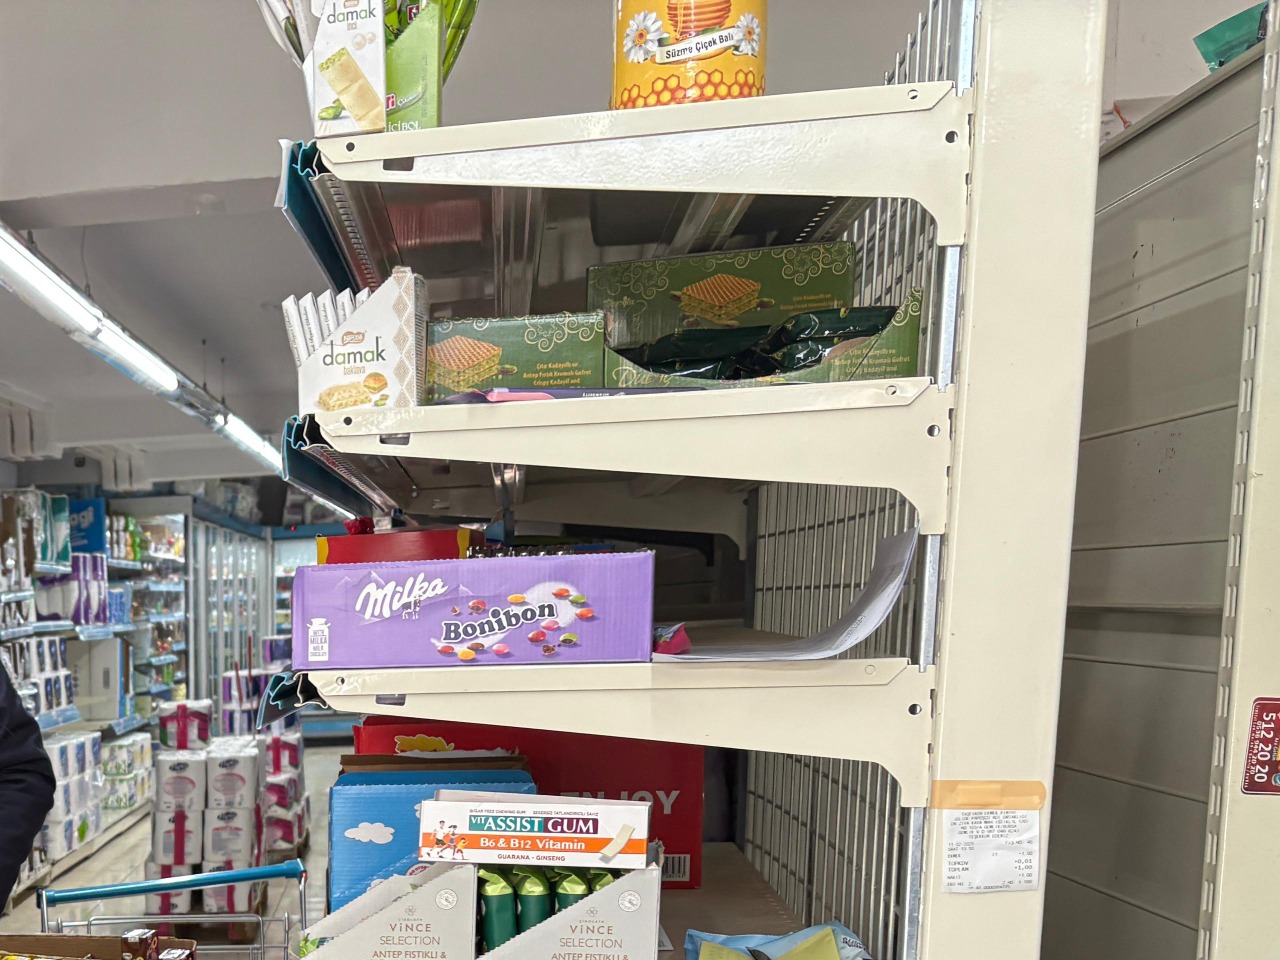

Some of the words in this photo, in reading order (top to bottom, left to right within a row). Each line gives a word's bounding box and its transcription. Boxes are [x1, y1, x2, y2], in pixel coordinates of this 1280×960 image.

[327, 1, 377, 24] damak
[666, 46, 693, 60] Süzme
[695, 36, 717, 54] Çiçek
[323, 336, 386, 366] damak
[343, 365, 366, 376] baklava
[574, 369, 592, 377] Gofret
[533, 379, 547, 387] Crispy
[355, 572, 448, 620] Milka
[442, 602, 558, 642] Bonibon
[310, 637, 327, 645] MILKA
[1260, 712, 1276, 739] 512
[1257, 743, 1271, 761] 20
[1254, 764, 1269, 783] 20
[547, 819, 594, 834] GUM
[480, 838, 495, 848] B6
[497, 838, 509, 848] &
[510, 838, 531, 849] B12
[536, 838, 586, 851] Vitamin
[497, 853, 530, 861] GUARANA
[536, 854, 566, 862] GINSENG
[380, 936, 441, 946] SELECTION
[559, 938, 623, 949] SELECTION
[372, 950, 403, 959] ANTEP
[405, 950, 438, 959] FISTIKLI
[440, 951, 447, 959] &
[551, 953, 582, 960] ANTEP
